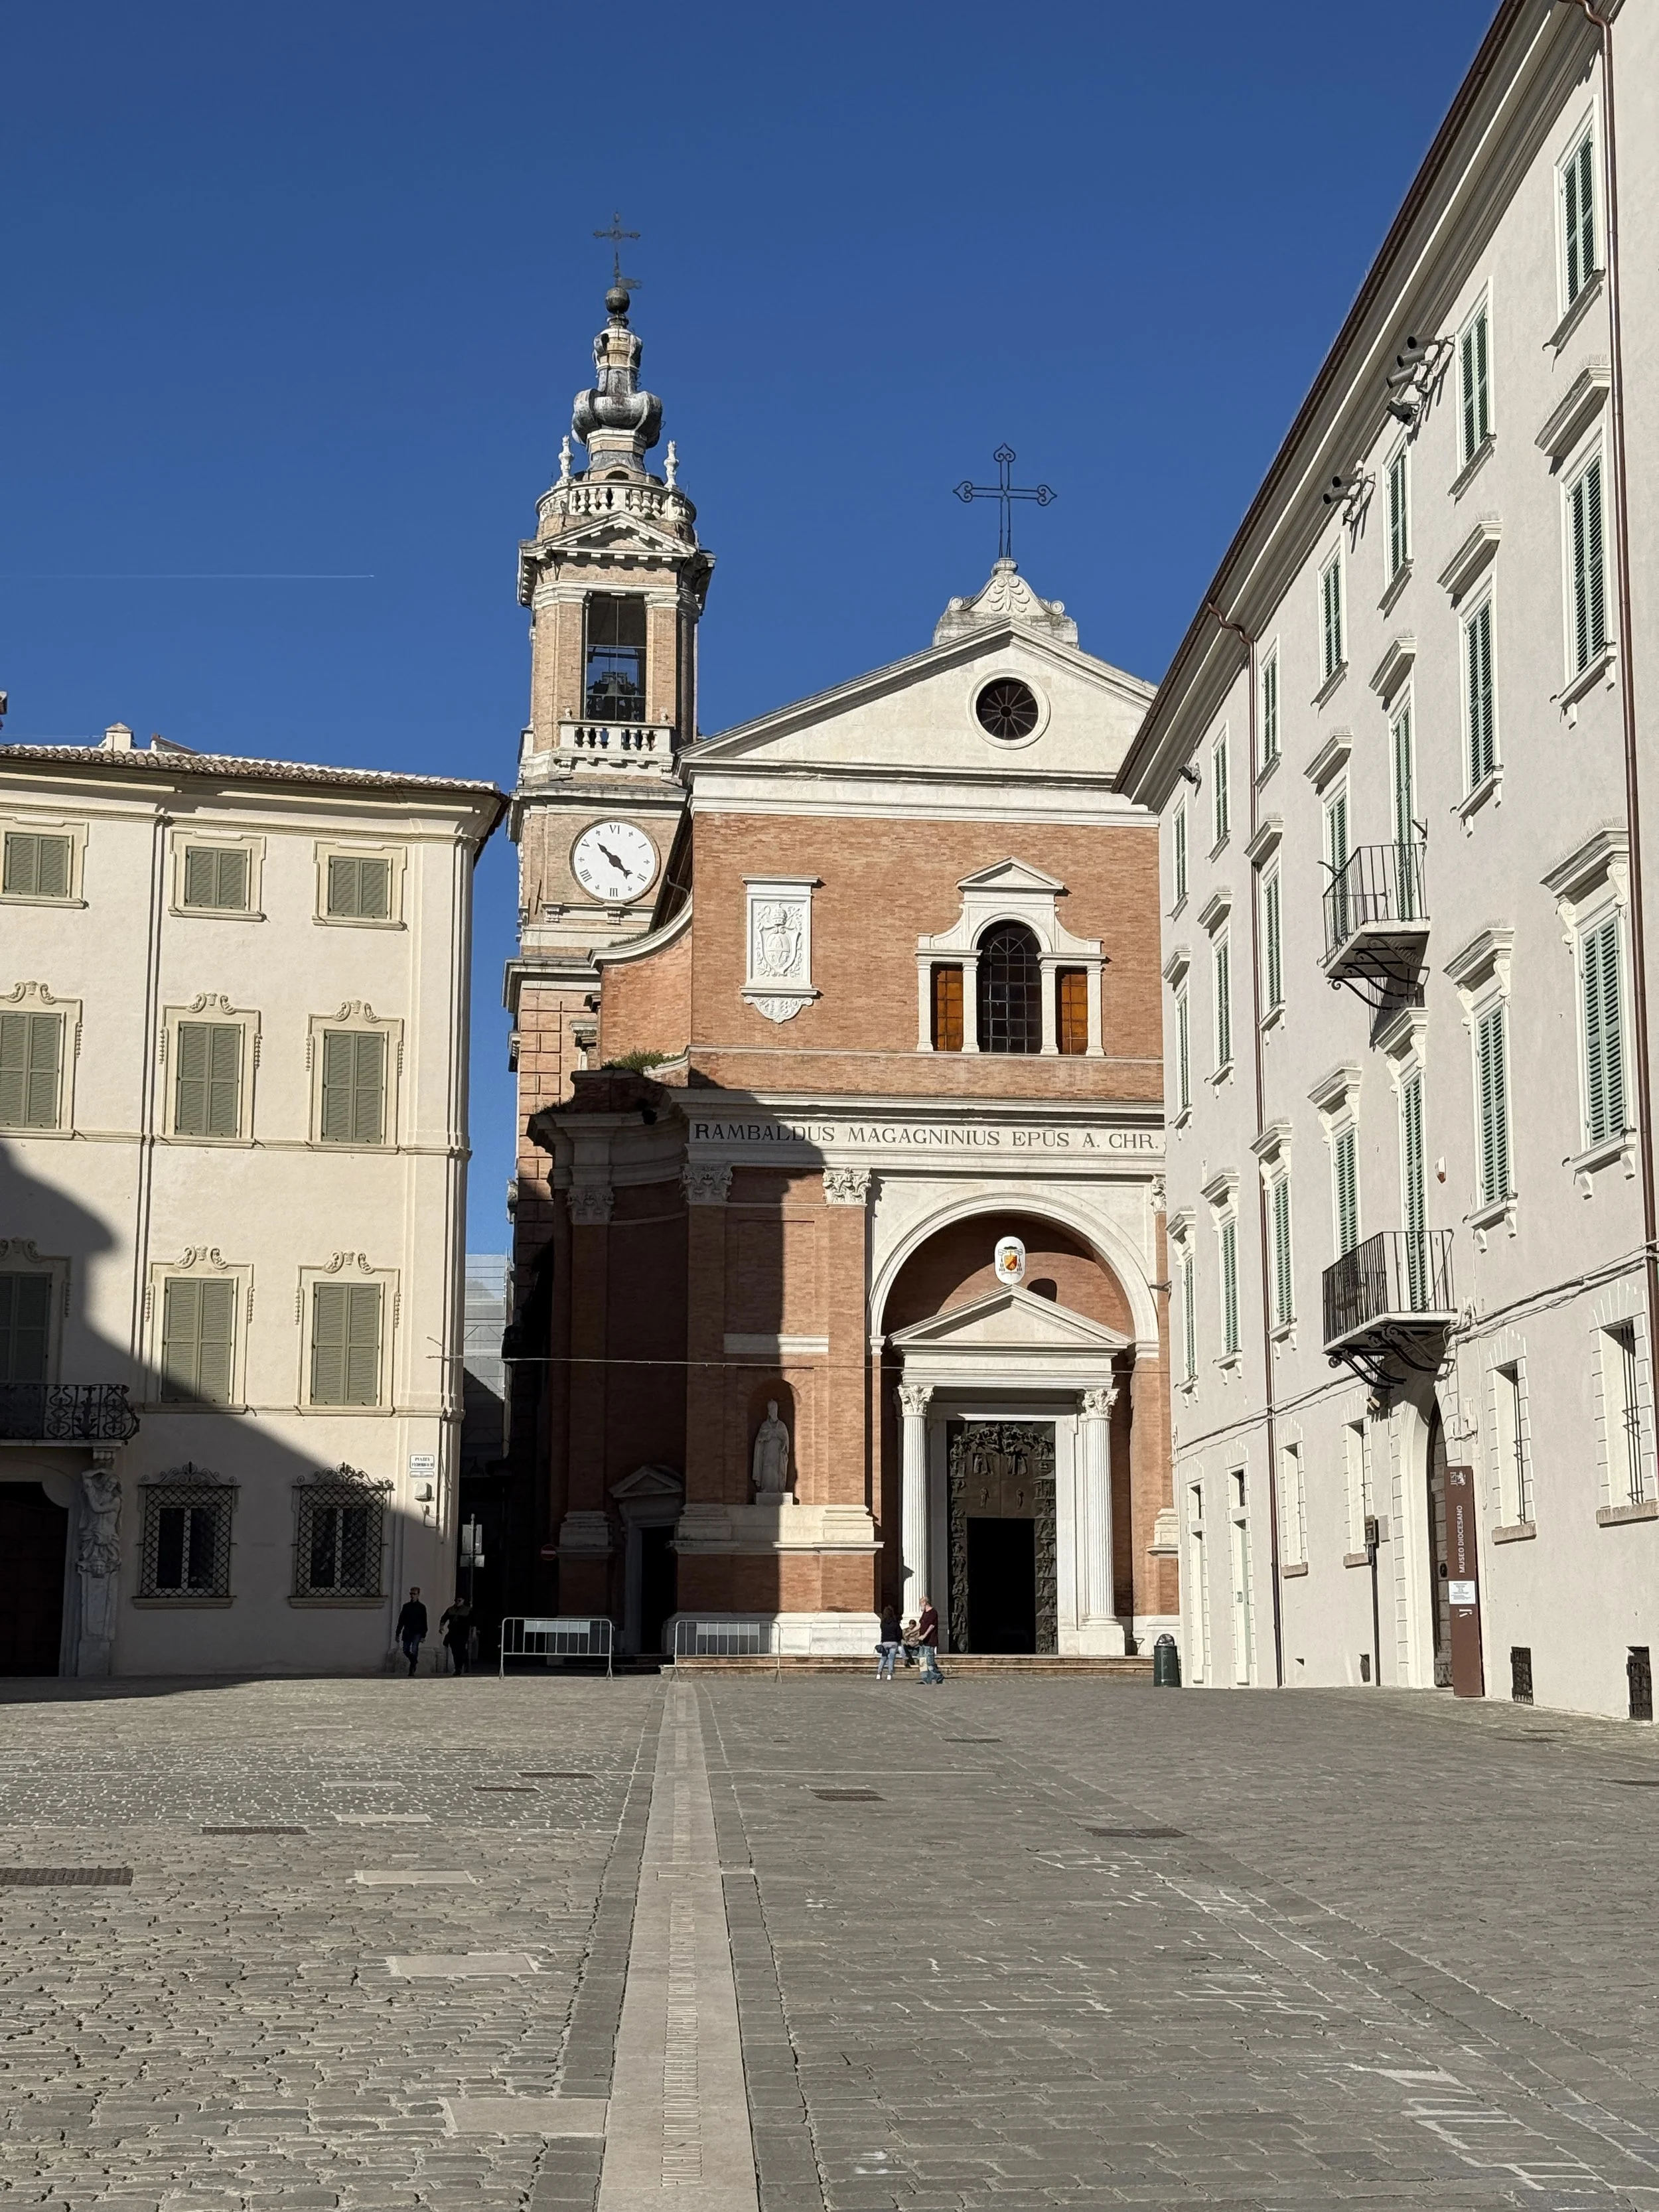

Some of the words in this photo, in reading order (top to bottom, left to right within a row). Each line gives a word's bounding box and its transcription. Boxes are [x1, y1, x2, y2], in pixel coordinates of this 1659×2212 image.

[609, 824, 620, 834] VI
[581, 839, 590, 848] V
[609, 887, 619, 897] III
[695, 1124, 835, 1142] RAMBALDUS
[847, 1126, 1000, 1145] MAGAGNINIUS
[1082, 1132, 1100, 1148] A.
[1109, 1134, 1159, 1149] CHR.
[660, 2141, 704, 2187] SVEVIA
